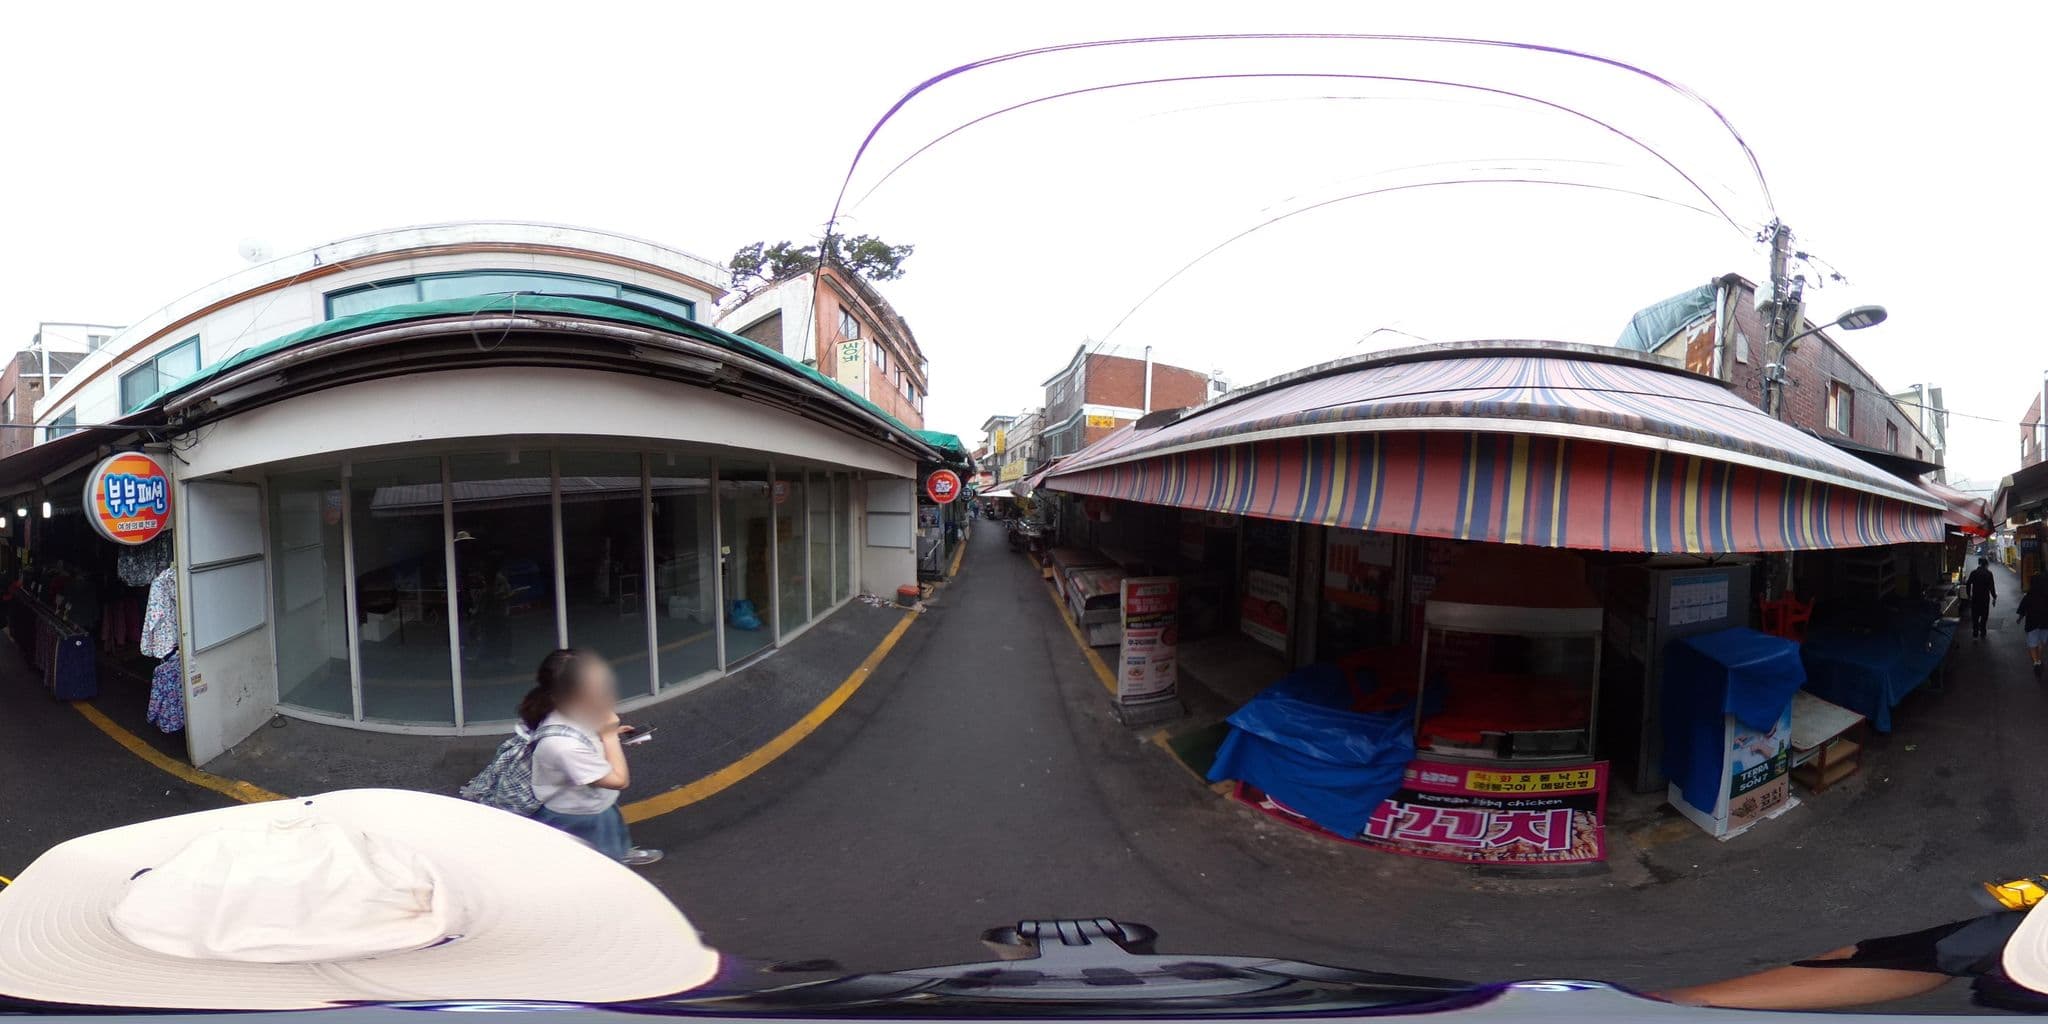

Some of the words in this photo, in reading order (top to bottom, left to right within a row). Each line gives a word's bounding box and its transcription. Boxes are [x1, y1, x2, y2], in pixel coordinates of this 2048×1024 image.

[106, 476, 165, 515] 부부패션
[1740, 763, 1769, 781] TERRA
[1507, 798, 1563, 807] chicken
